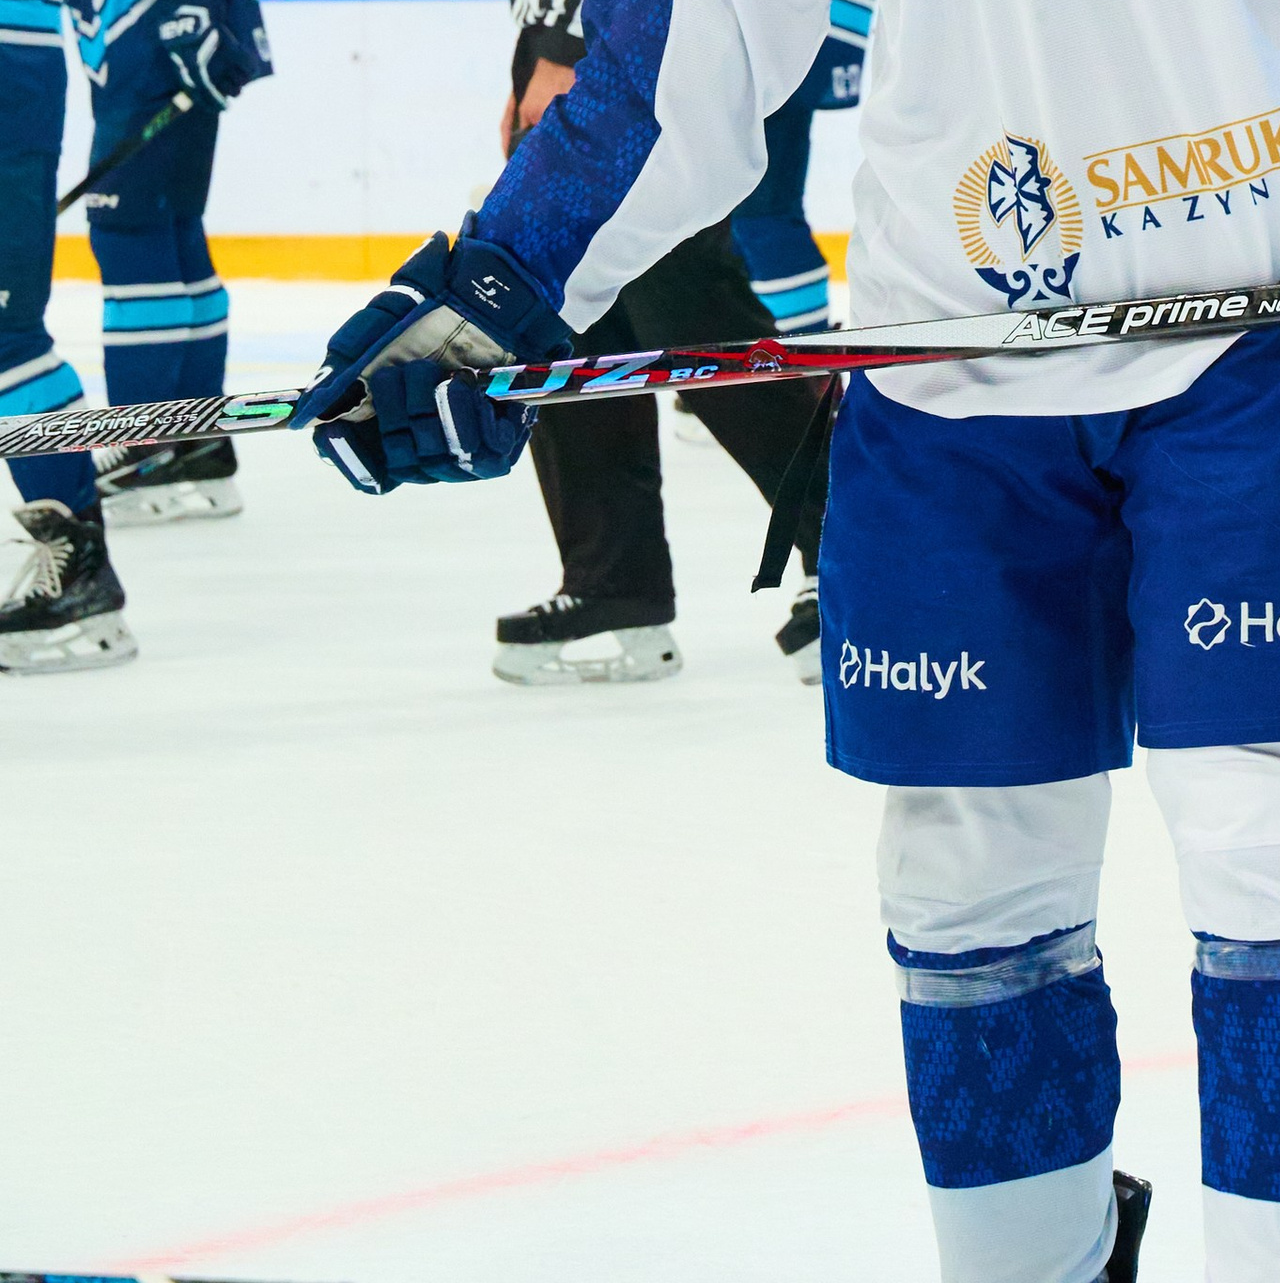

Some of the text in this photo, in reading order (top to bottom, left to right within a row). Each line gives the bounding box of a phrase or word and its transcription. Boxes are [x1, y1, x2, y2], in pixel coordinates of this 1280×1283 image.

[1002, 306, 1115, 345] ACE
[1120, 294, 1249, 335] prime
[25, 417, 82, 438] ACE
[84, 413, 150, 436] prime
[864, 647, 988, 700] Halyk
